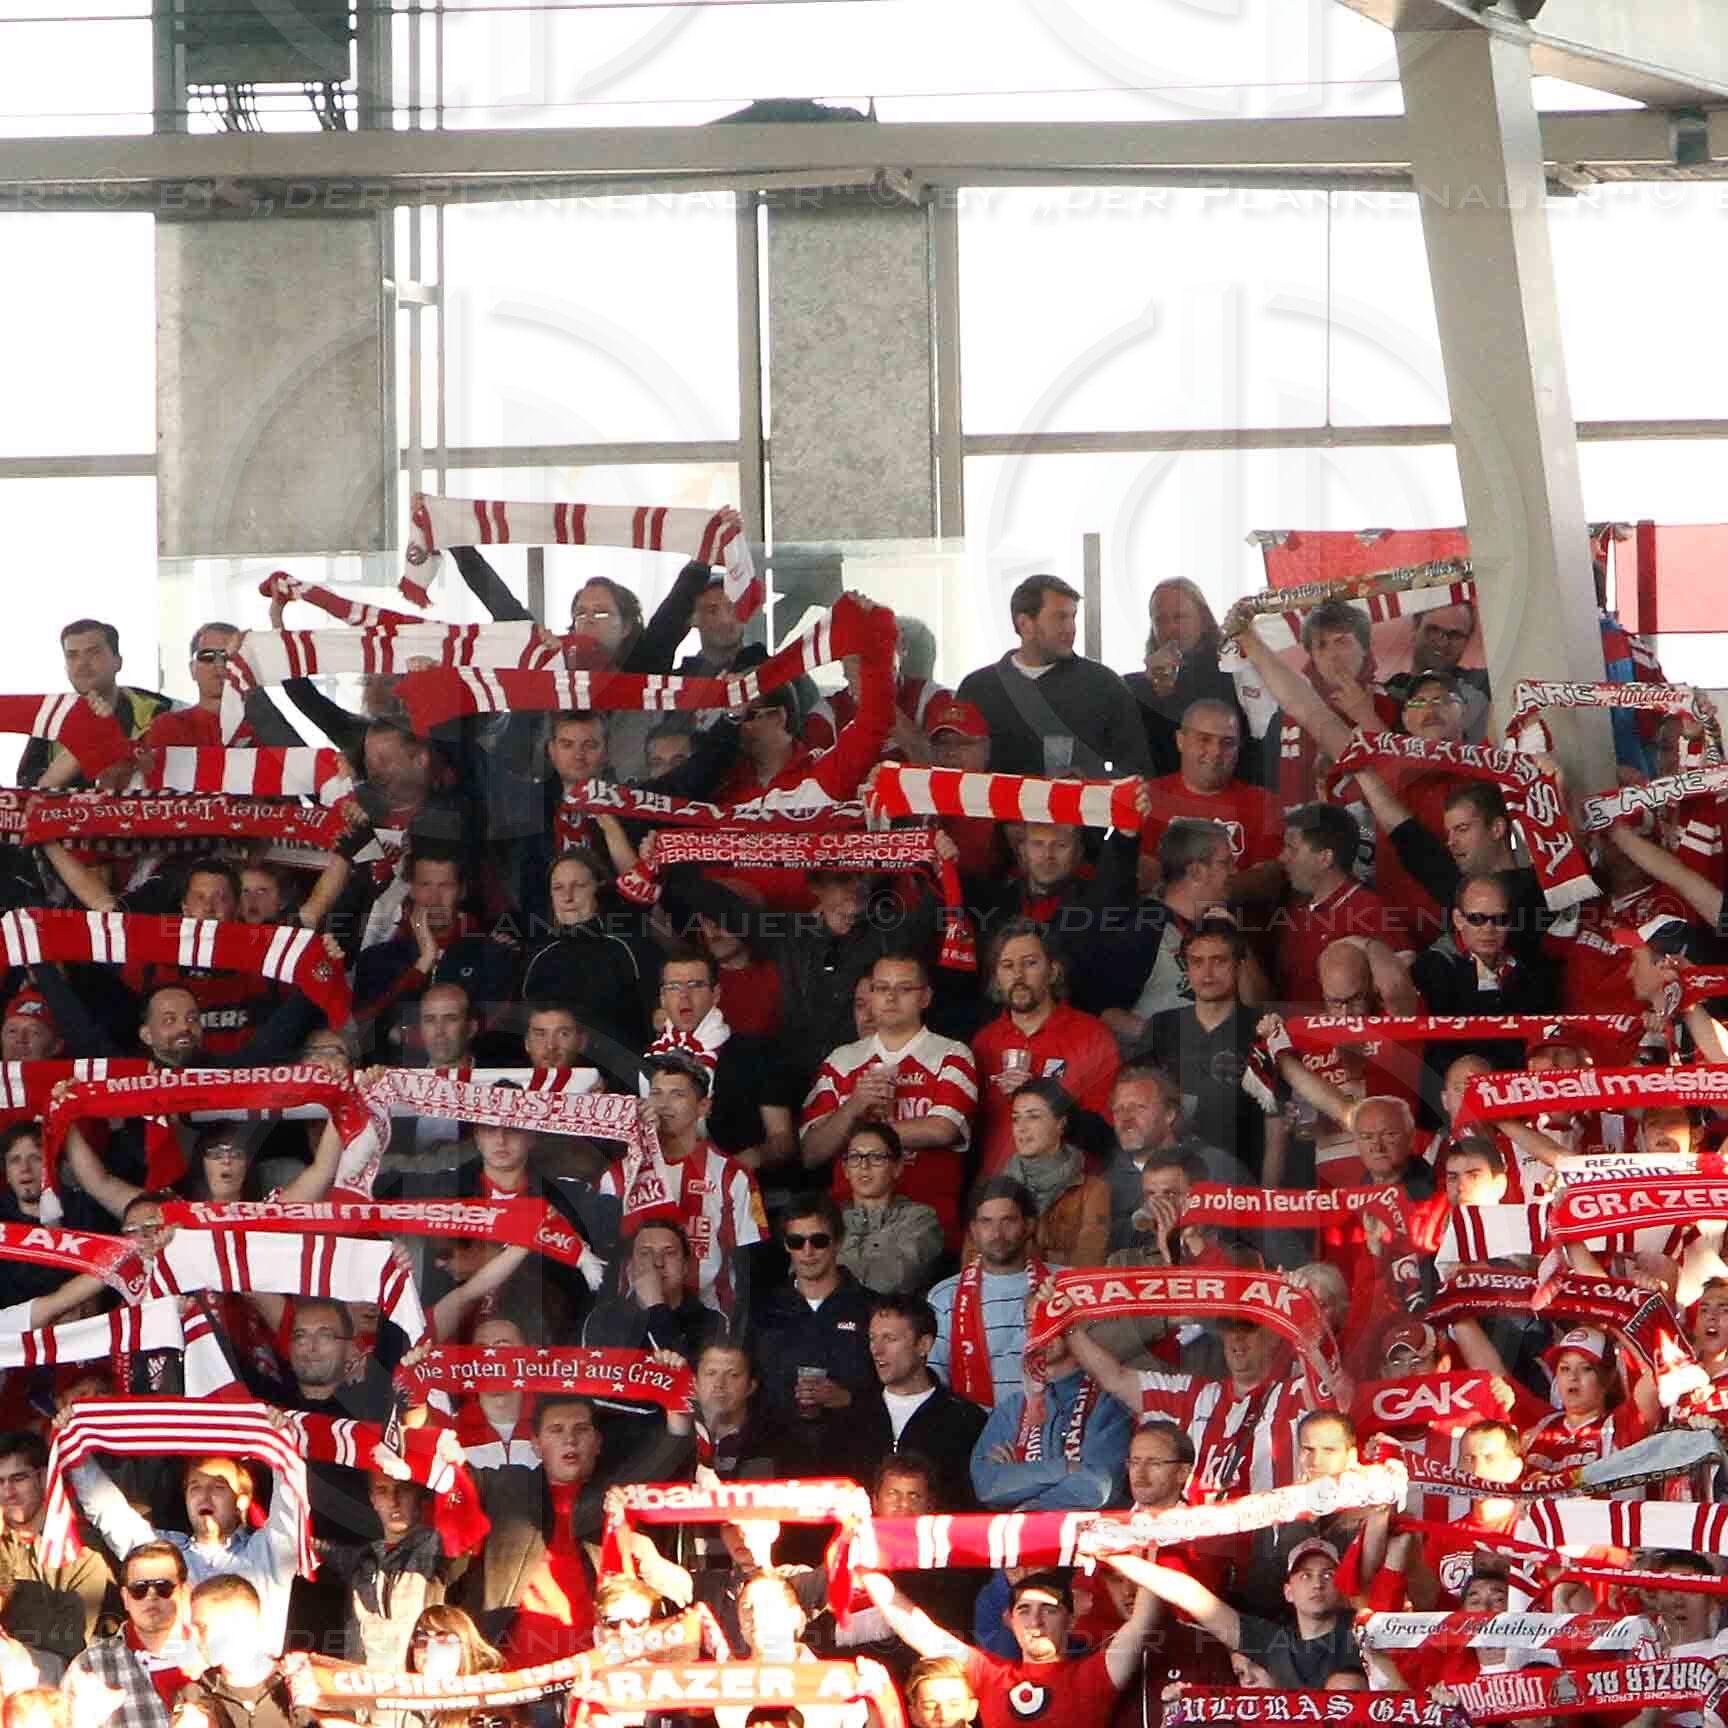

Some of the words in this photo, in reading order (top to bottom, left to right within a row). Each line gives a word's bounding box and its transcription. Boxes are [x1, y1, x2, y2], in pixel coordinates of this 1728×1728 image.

[1476, 1072, 1601, 1109] fußball
[1204, 1192, 1260, 1211] roten
[1262, 1189, 1339, 1211] Teufel
[22, 1228, 89, 1255] AK
[1048, 1280, 1226, 1320] GRAZER
[1240, 1283, 1295, 1315] AK
[415, 1363, 443, 1380] Die
[450, 1360, 507, 1377] roten
[514, 1358, 580, 1377] Teufel
[585, 1362, 623, 1377] aus
[628, 1365, 673, 1388] Graz
[1374, 1378, 1481, 1421] GAK
[1381, 1617, 1449, 1640] Grazer
[1176, 1692, 1354, 1726] ULTRAS
